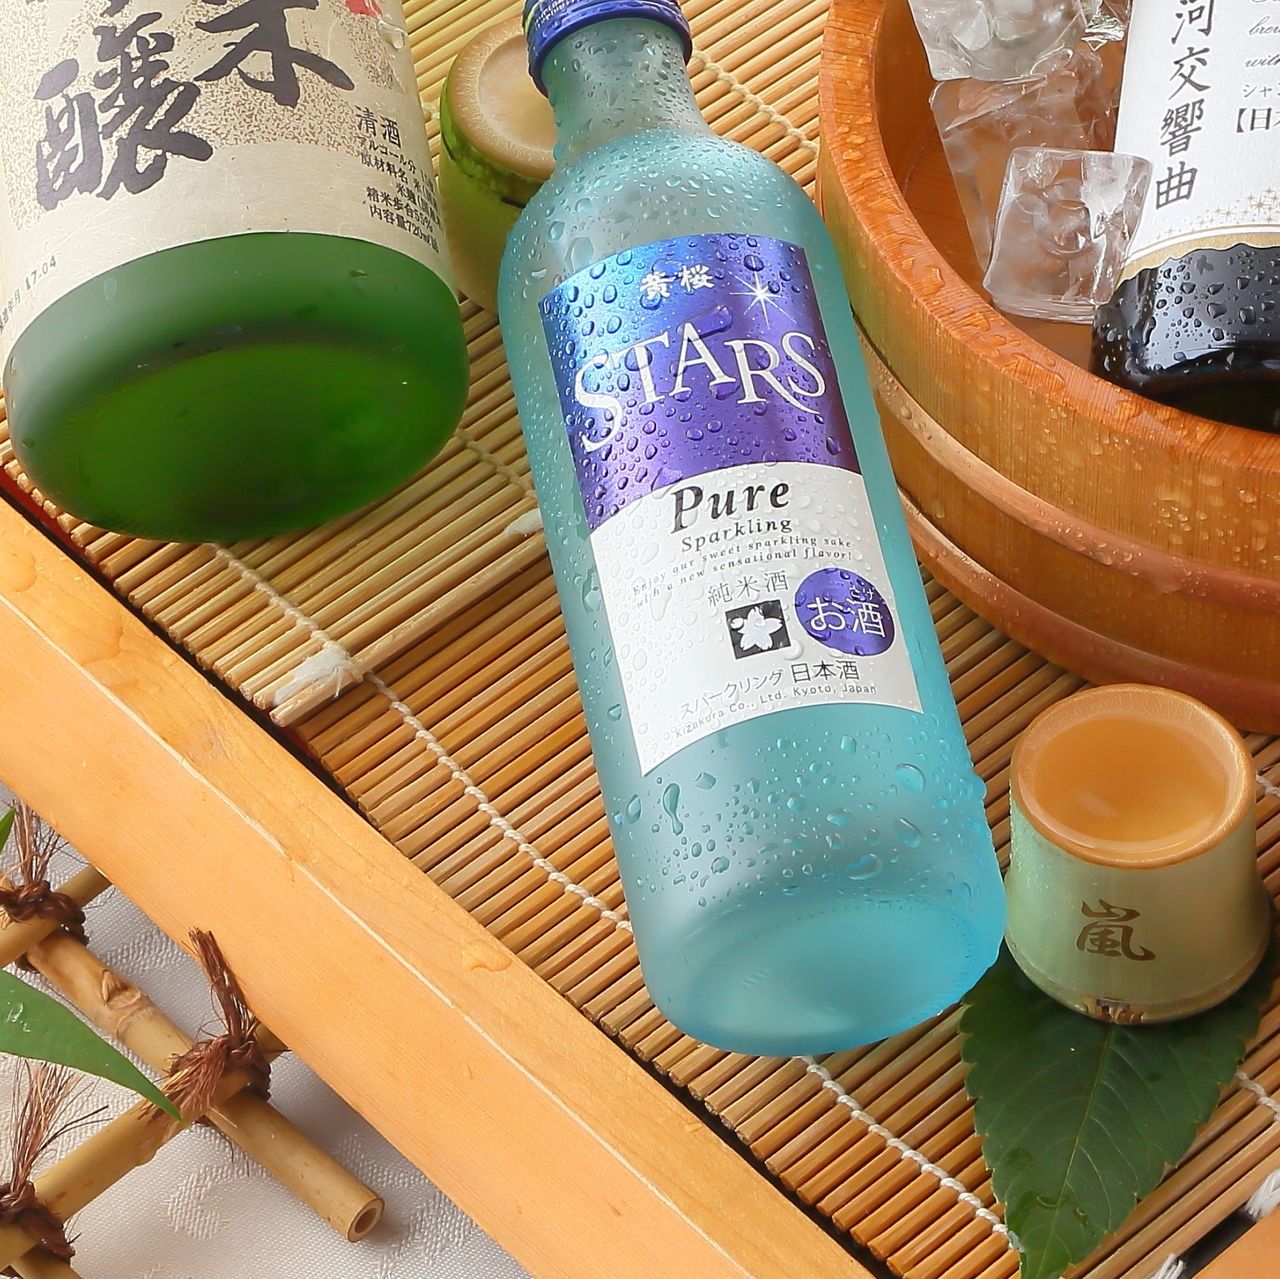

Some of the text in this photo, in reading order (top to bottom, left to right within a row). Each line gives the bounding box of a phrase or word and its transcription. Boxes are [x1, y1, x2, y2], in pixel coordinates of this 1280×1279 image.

[354, 104, 402, 149] 清酒
[640, 263, 716, 299] 黄桜
[573, 321, 827, 454] STARS
[670, 481, 791, 534] Pure
[672, 559, 696, 574] our
[702, 545, 741, 563] sweet
[748, 535, 818, 551] sparkling
[824, 536, 853, 548] sake
[681, 519, 793, 553] Sparkling
[680, 569, 706, 585] new
[713, 549, 798, 573] sensational
[804, 545, 853, 561] flavor!
[706, 569, 790, 608] 純米酒
[806, 596, 886, 638] お酒
[790, 659, 861, 685] 日本酒
[728, 701, 755, 714] Co.,
[759, 693, 788, 705] Ltd.
[793, 683, 838, 697] Kyoto,
[841, 682, 878, 696] Japan
[1075, 898, 1157, 962] 嵐
